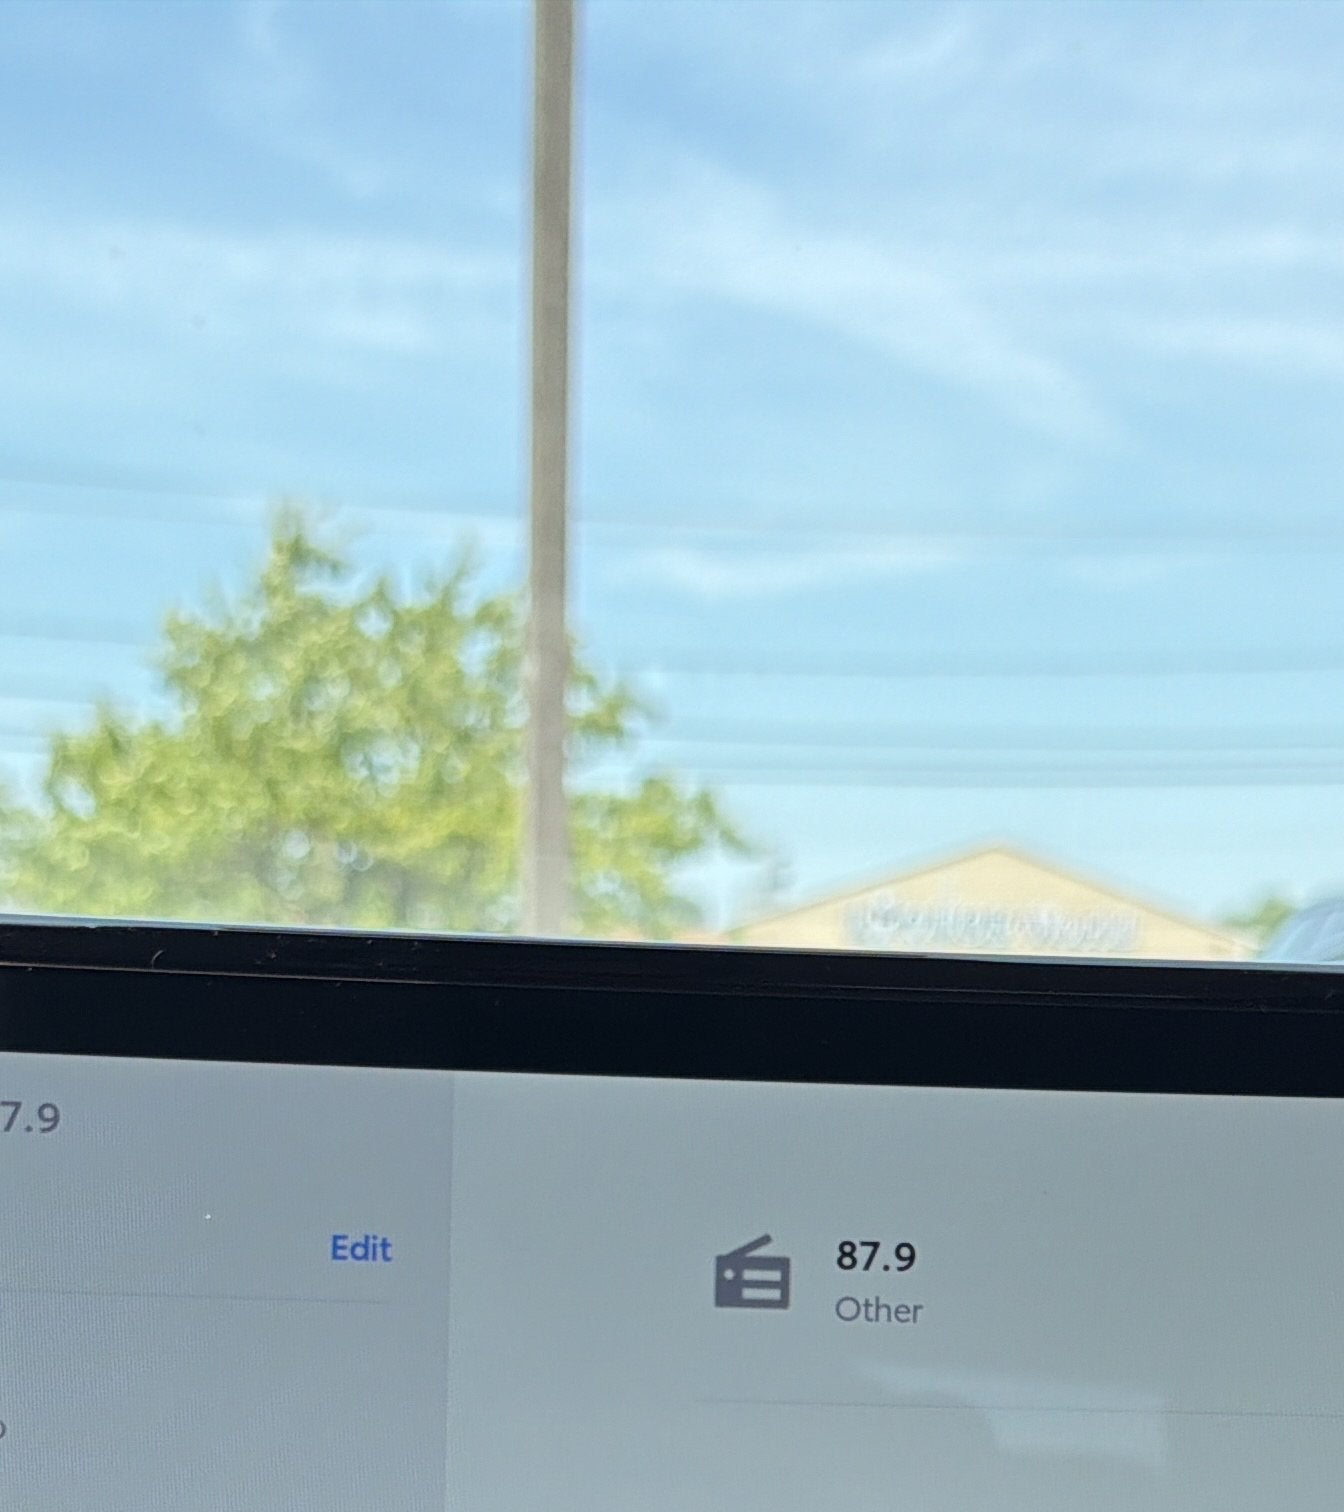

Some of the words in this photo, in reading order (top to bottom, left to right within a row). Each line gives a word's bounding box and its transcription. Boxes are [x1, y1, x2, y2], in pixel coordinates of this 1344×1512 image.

[330, 1234, 393, 1263] Edit
[836, 1240, 916, 1272] 87.9
[834, 1296, 924, 1325] Other
